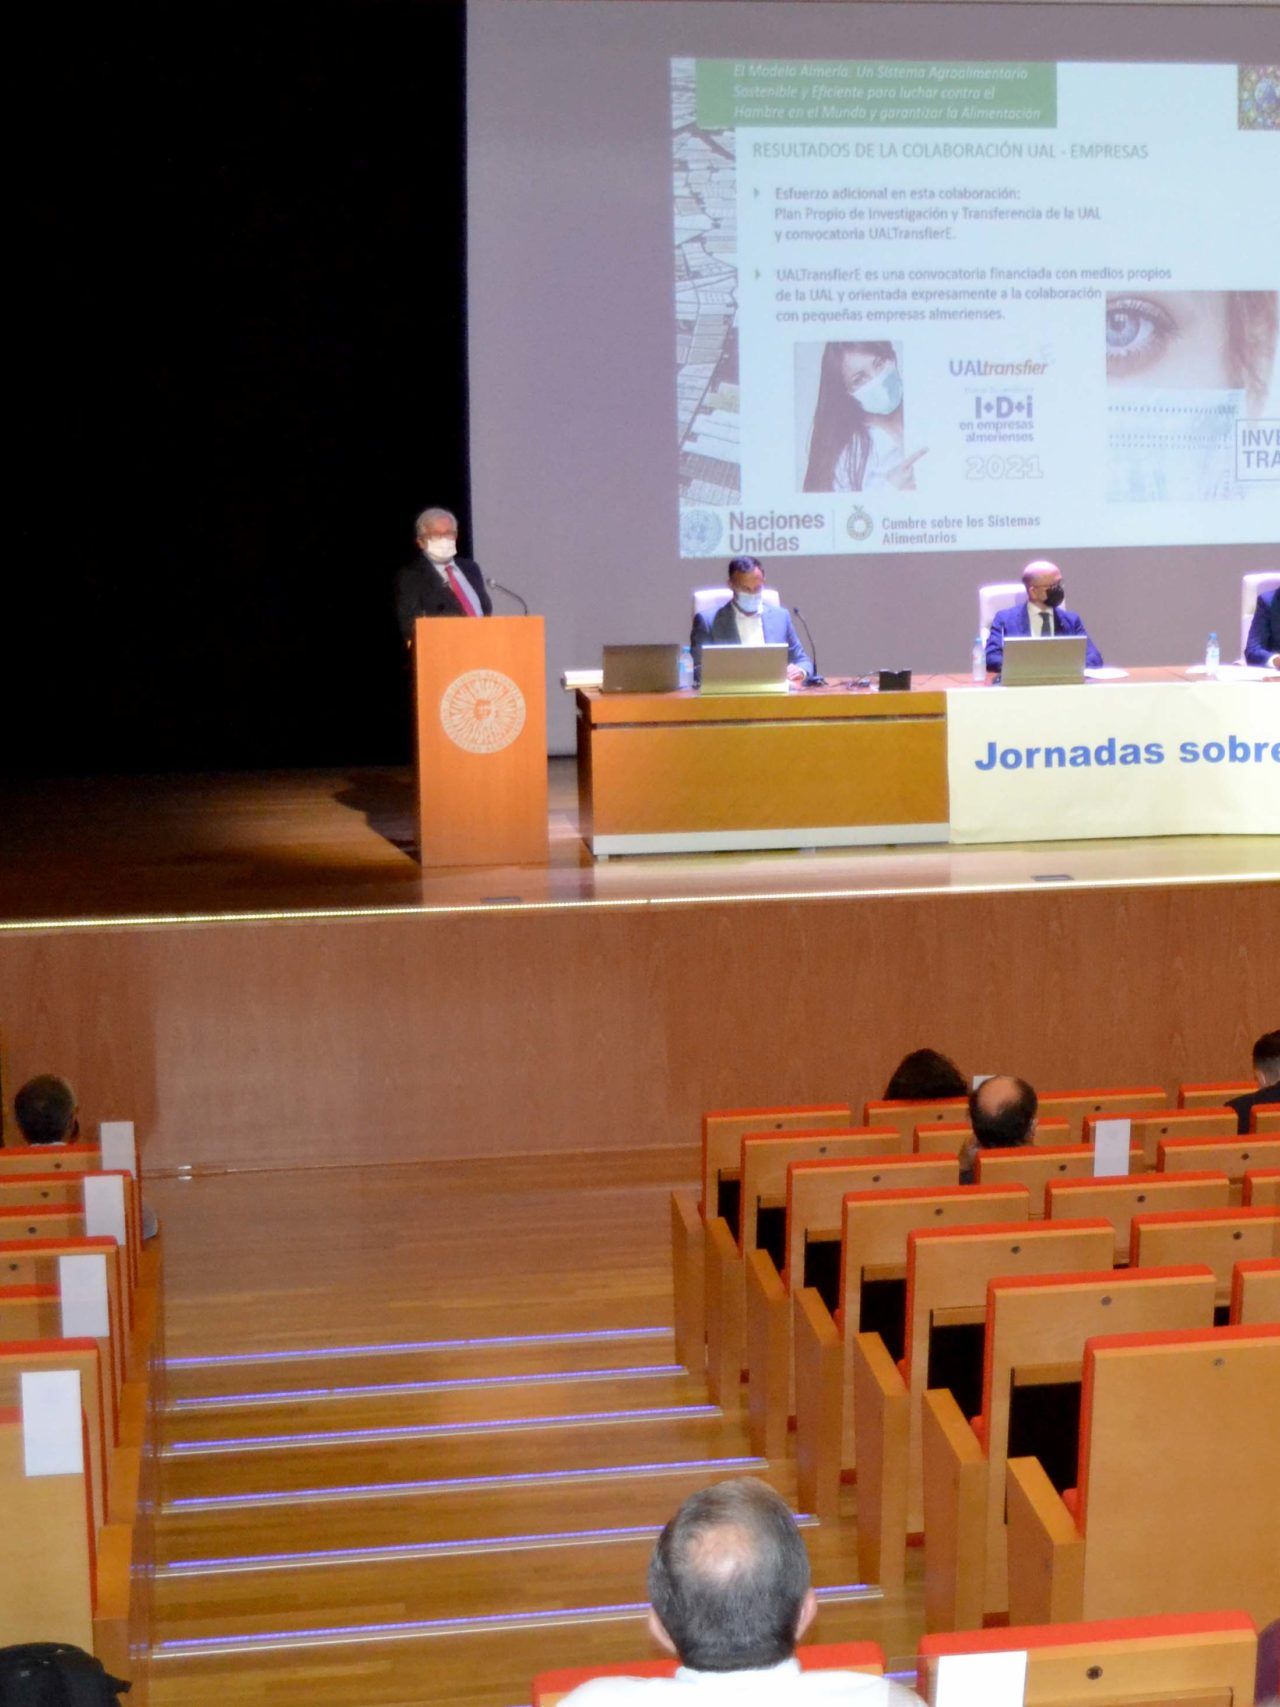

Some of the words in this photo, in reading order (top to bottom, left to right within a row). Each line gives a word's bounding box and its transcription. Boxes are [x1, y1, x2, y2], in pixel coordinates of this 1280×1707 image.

[856, 65, 873, 78] Un
[877, 65, 925, 79] Sistema
[733, 84, 797, 98] Sostenible
[801, 88, 808, 100] y
[812, 85, 864, 100] Eficiente
[899, 85, 938, 99] luchar
[941, 88, 980, 99] contra
[984, 87, 996, 99] el
[788, 107, 804, 119] en
[807, 105, 819, 119] el
[869, 109, 877, 121] y
[879, 107, 942, 122] garantizar
[946, 107, 958, 119] la
[753, 143, 850, 158] RESULTADOS
[855, 144, 874, 158] DE
[880, 144, 898, 158] LA
[902, 141, 1023, 159] COLABORACIÓN
[1027, 144, 1056, 159] UAL
[1070, 144, 1149, 159] EMPRESAS
[775, 187, 828, 200] Esfuerzo
[832, 187, 887, 200] adicional
[891, 190, 906, 200] en
[910, 188, 935, 200] esta
[774, 207, 802, 220] Plan
[805, 207, 846, 222] Propio
[850, 207, 864, 220] de
[869, 207, 948, 222] Investigación
[951, 210, 958, 221] y
[961, 207, 1042, 220] Transferencia
[1045, 207, 1061, 220] de
[1064, 207, 1074, 220] la
[1078, 207, 1102, 220] UAL
[775, 230, 782, 243] y
[785, 228, 864, 241] convocatoria
[776, 268, 861, 282] UALTransfierE
[865, 271, 879, 281] es
[882, 271, 904, 281] una
[908, 268, 986, 281] convocatoria
[990, 267, 1051, 280] financiada
[1055, 270, 1078, 280] con
[1081, 267, 1124, 280] medios
[1127, 268, 1172, 282] propios
[775, 289, 792, 301] de
[795, 289, 806, 301] la
[809, 289, 833, 301] UAL
[838, 291, 845, 303] y
[848, 288, 907, 301] orientada
[911, 288, 997, 302] expresamente
[1000, 290, 1008, 299] a
[1012, 287, 1022, 299] la
[1025, 286, 1102, 299] colaboración
[776, 311, 798, 322] con
[802, 309, 863, 324] pequeñas
[866, 310, 926, 323] empresas
[959, 421, 974, 430] en
[977, 420, 1034, 432] empresas
[965, 432, 1034, 442] almerienses
[965, 454, 1044, 480] 2021
[729, 509, 825, 531] Naciones
[882, 516, 928, 530] Cumbre
[931, 515, 963, 529] sobre
[966, 515, 984, 528] los
[987, 514, 1041, 528] Sistemas
[729, 532, 800, 552] Unidas
[882, 530, 957, 545] Alimentarios
[974, 737, 1165, 772] Jornadas
